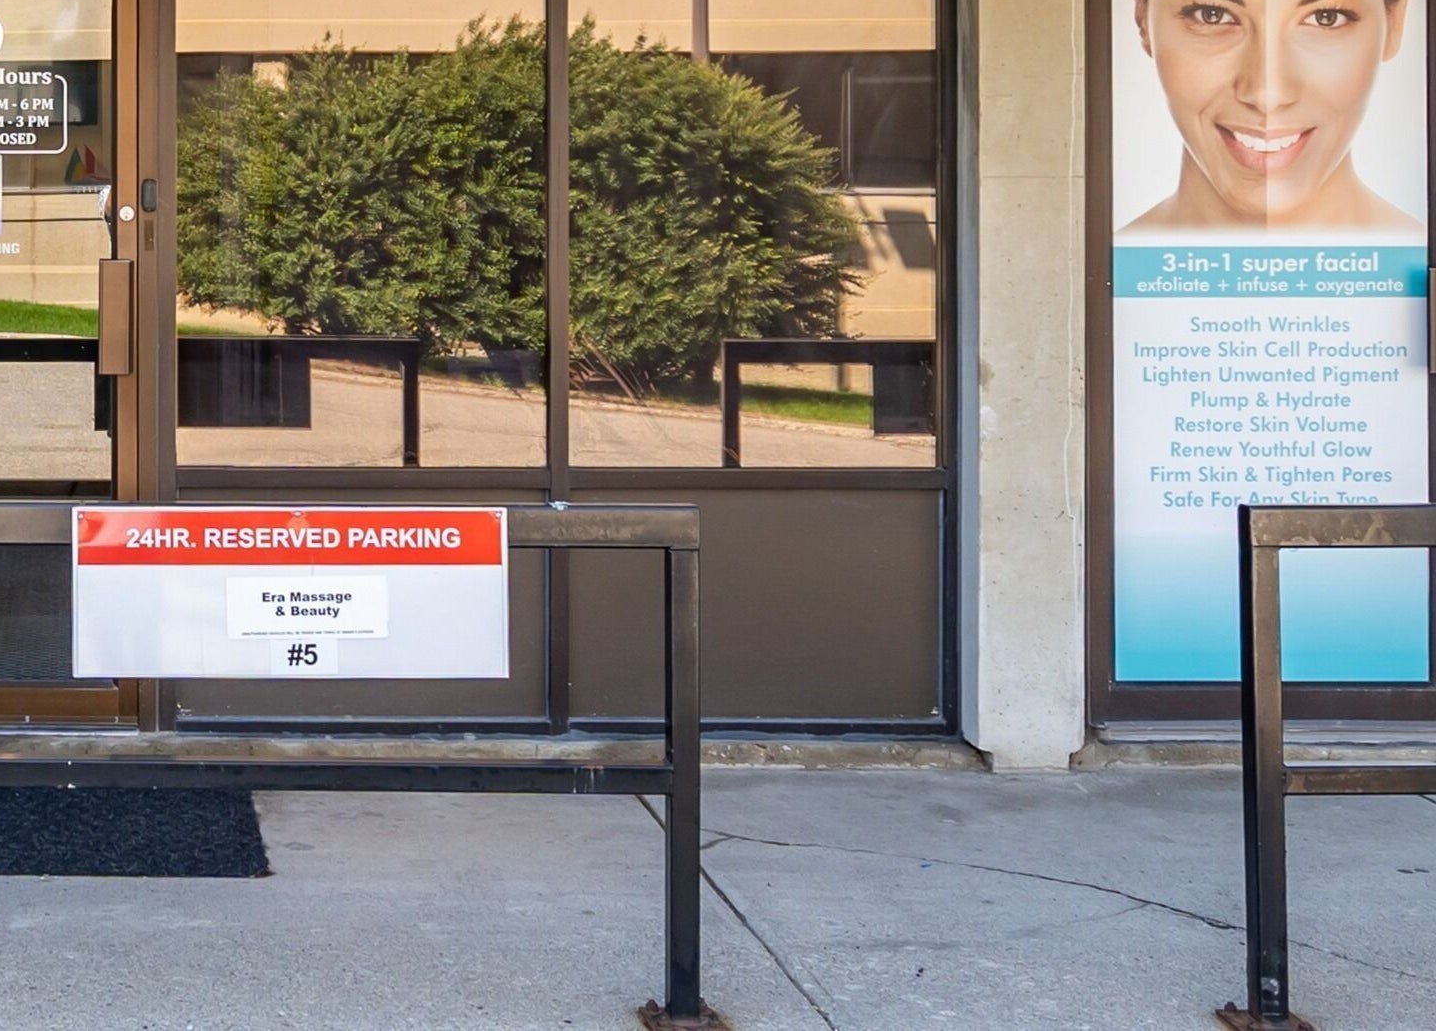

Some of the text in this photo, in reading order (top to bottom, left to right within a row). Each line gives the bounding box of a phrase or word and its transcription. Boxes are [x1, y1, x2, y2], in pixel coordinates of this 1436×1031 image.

[20, 98, 29, 111] 6
[32, 98, 54, 111] PM
[15, 115, 24, 128] 3
[26, 115, 49, 128] PM
[1162, 252, 1379, 276] 3-in-1 super facial
[1136, 277, 1404, 295] exfoliate + infuse + oxygenate
[1190, 317, 1350, 332] Smooth Wrinkles
[1133, 341, 1407, 361] Improve Skin Cell Production
[1142, 366, 1399, 386] Lighten Unwanted Pigment
[1190, 391, 1351, 411] Plump & Hydrate
[1174, 416, 1367, 433] Restore Skin Volume
[1170, 441, 1372, 458] Renew Youthful Glow
[1150, 466, 1392, 486] Firm Skin & Tighten Pores
[1163, 492, 1204, 507] Safe
[1211, 492, 1241, 507] For
[1248, 492, 1284, 503] Any
[1290, 491, 1330, 503] Skin
[126, 527, 461, 549] 24HR. RESERVED PARKING
[261, 591, 352, 605] Era Massage
[274, 605, 341, 618] & Beauty
[287, 643, 319, 666] #5
